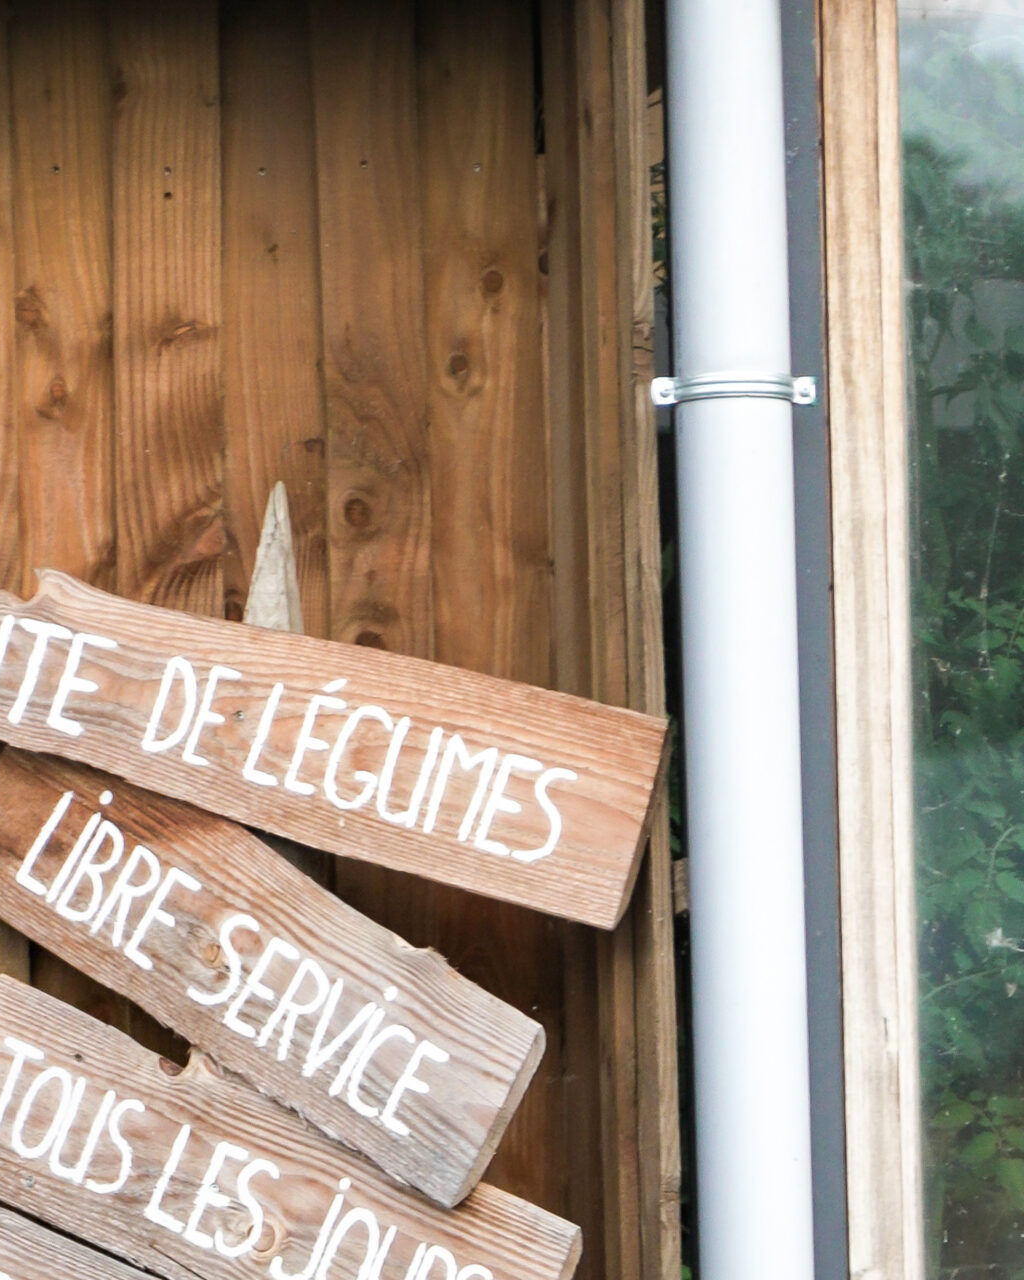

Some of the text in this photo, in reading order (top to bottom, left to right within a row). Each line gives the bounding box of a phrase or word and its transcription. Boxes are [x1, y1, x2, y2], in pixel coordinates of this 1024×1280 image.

[141, 655, 244, 768] DE
[242, 678, 579, 863] LÉGUMES
[143, 1124, 280, 1259] LES
